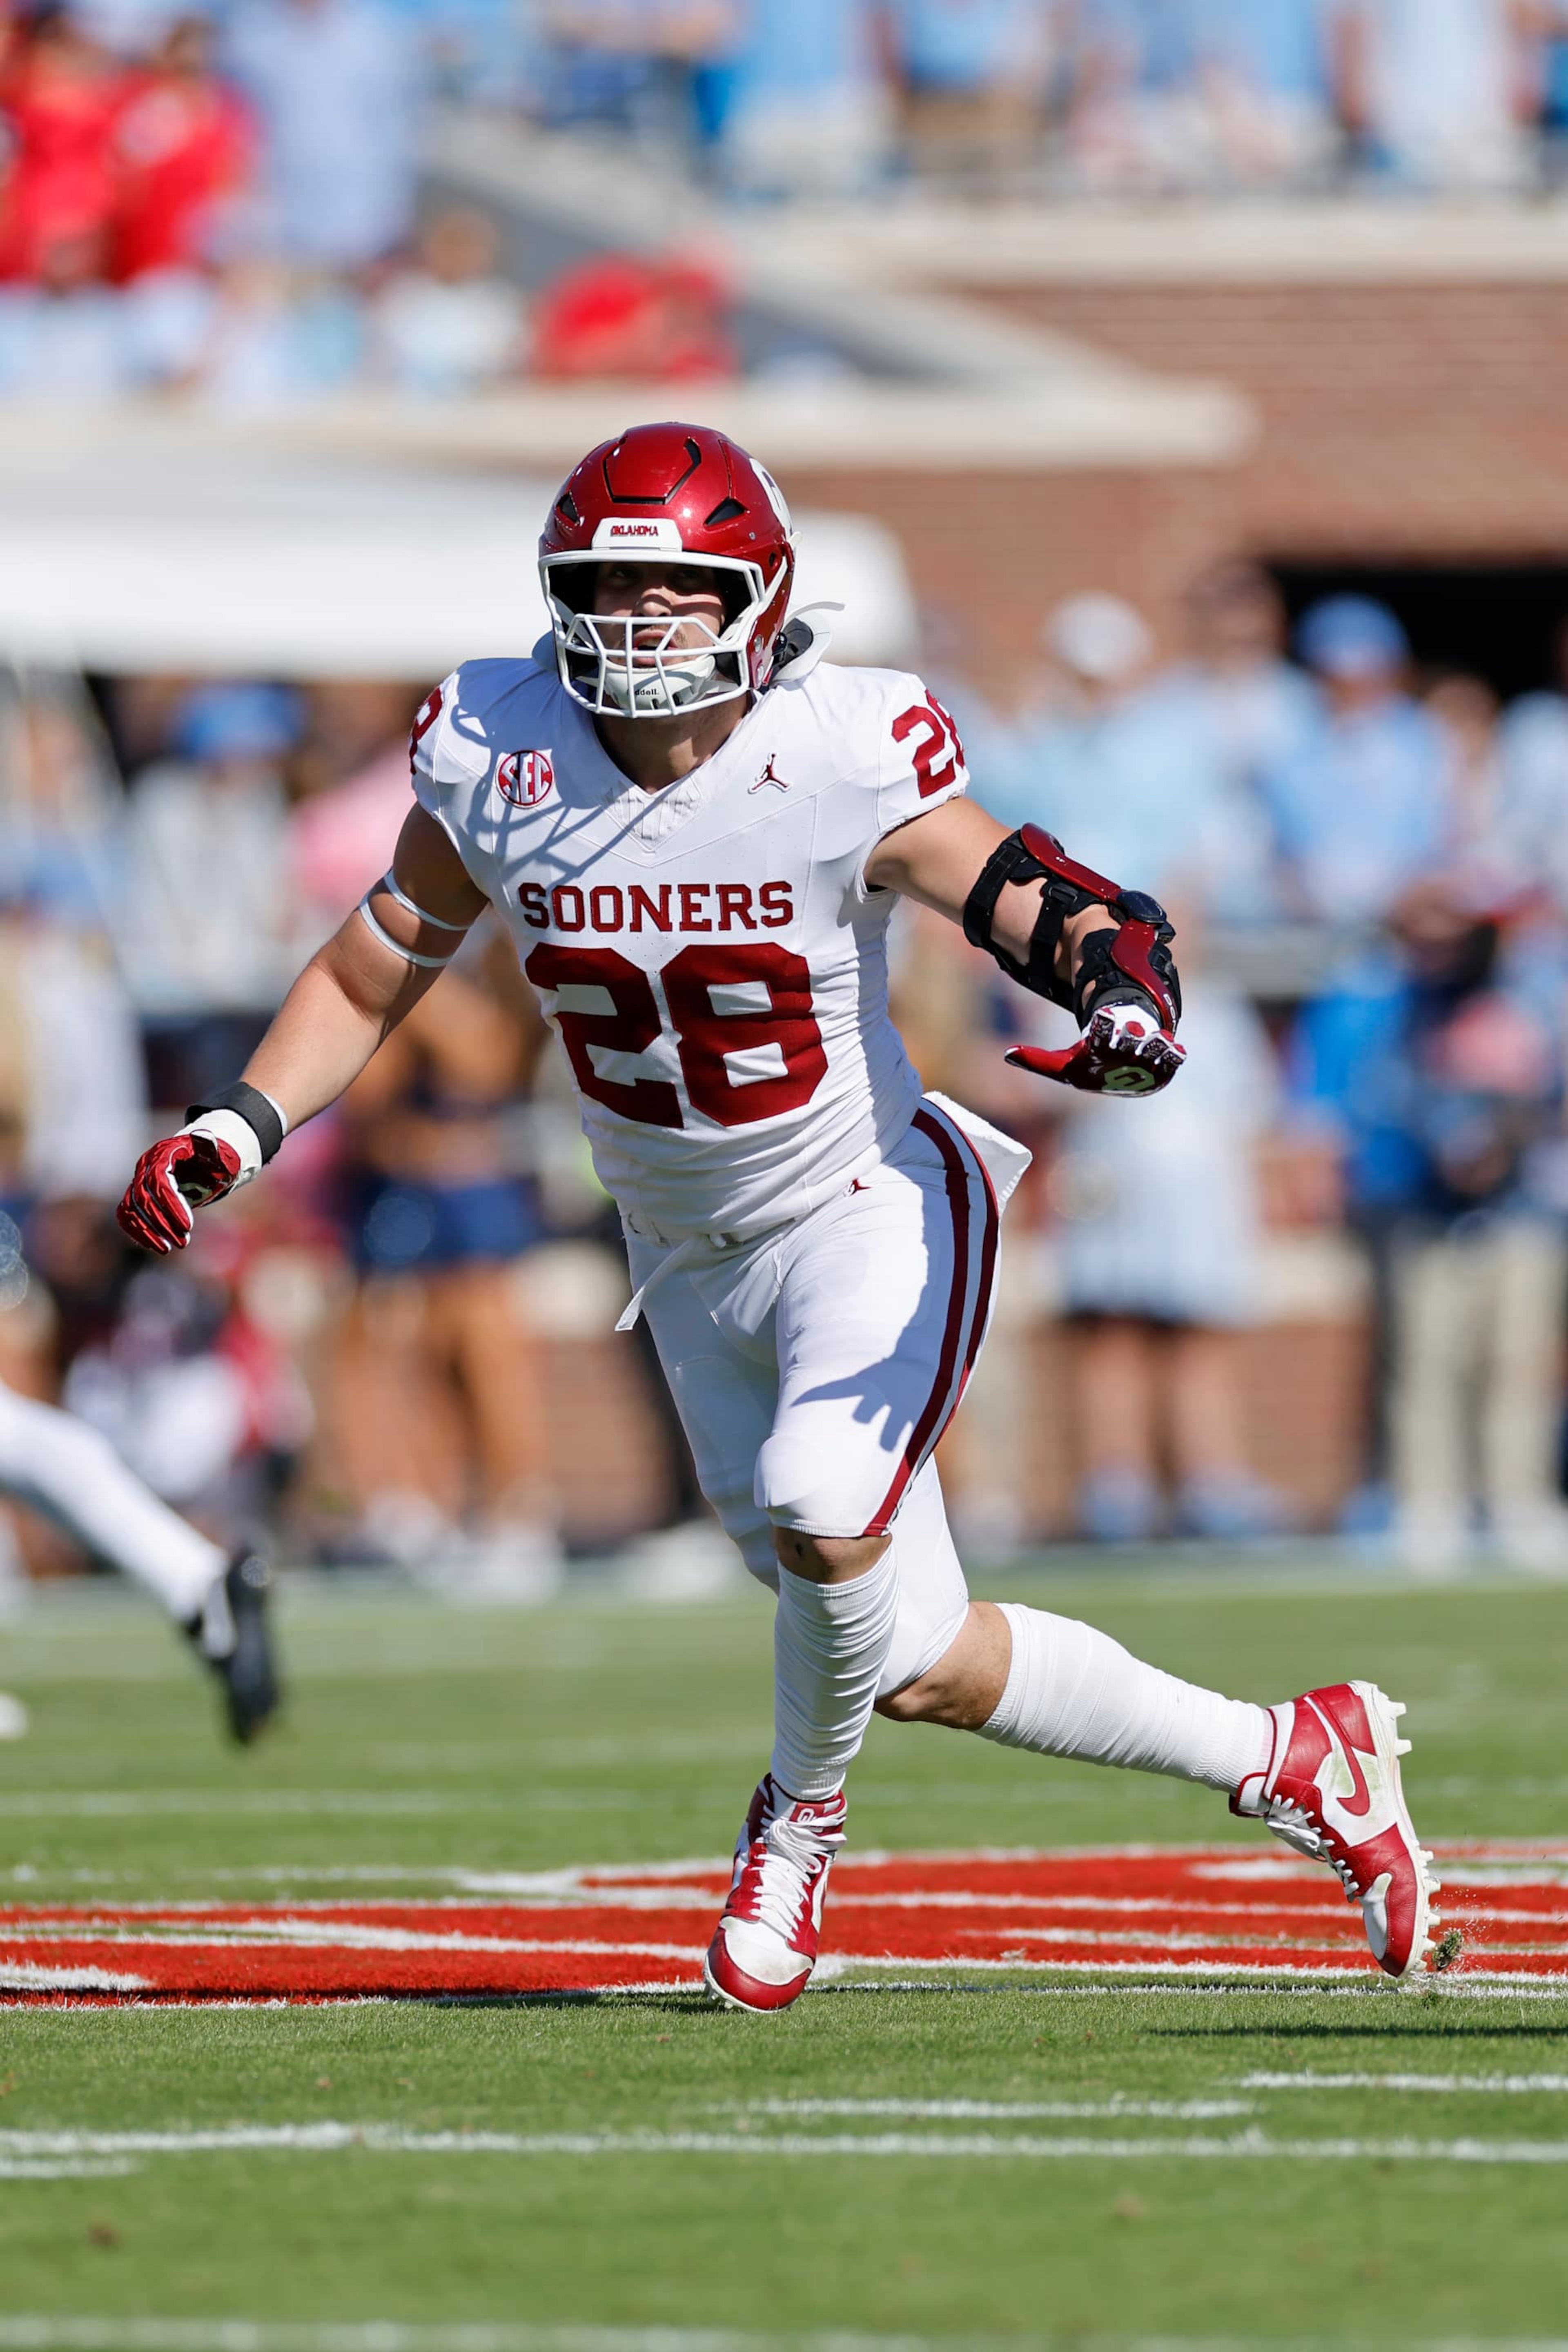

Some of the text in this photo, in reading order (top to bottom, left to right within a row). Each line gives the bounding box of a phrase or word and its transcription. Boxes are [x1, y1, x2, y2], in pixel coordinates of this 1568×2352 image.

[610, 525, 659, 537] OKLAHOMA
[501, 752, 550, 804] SEC
[518, 881, 793, 932] SOONERS
[525, 942, 829, 1129] 28
